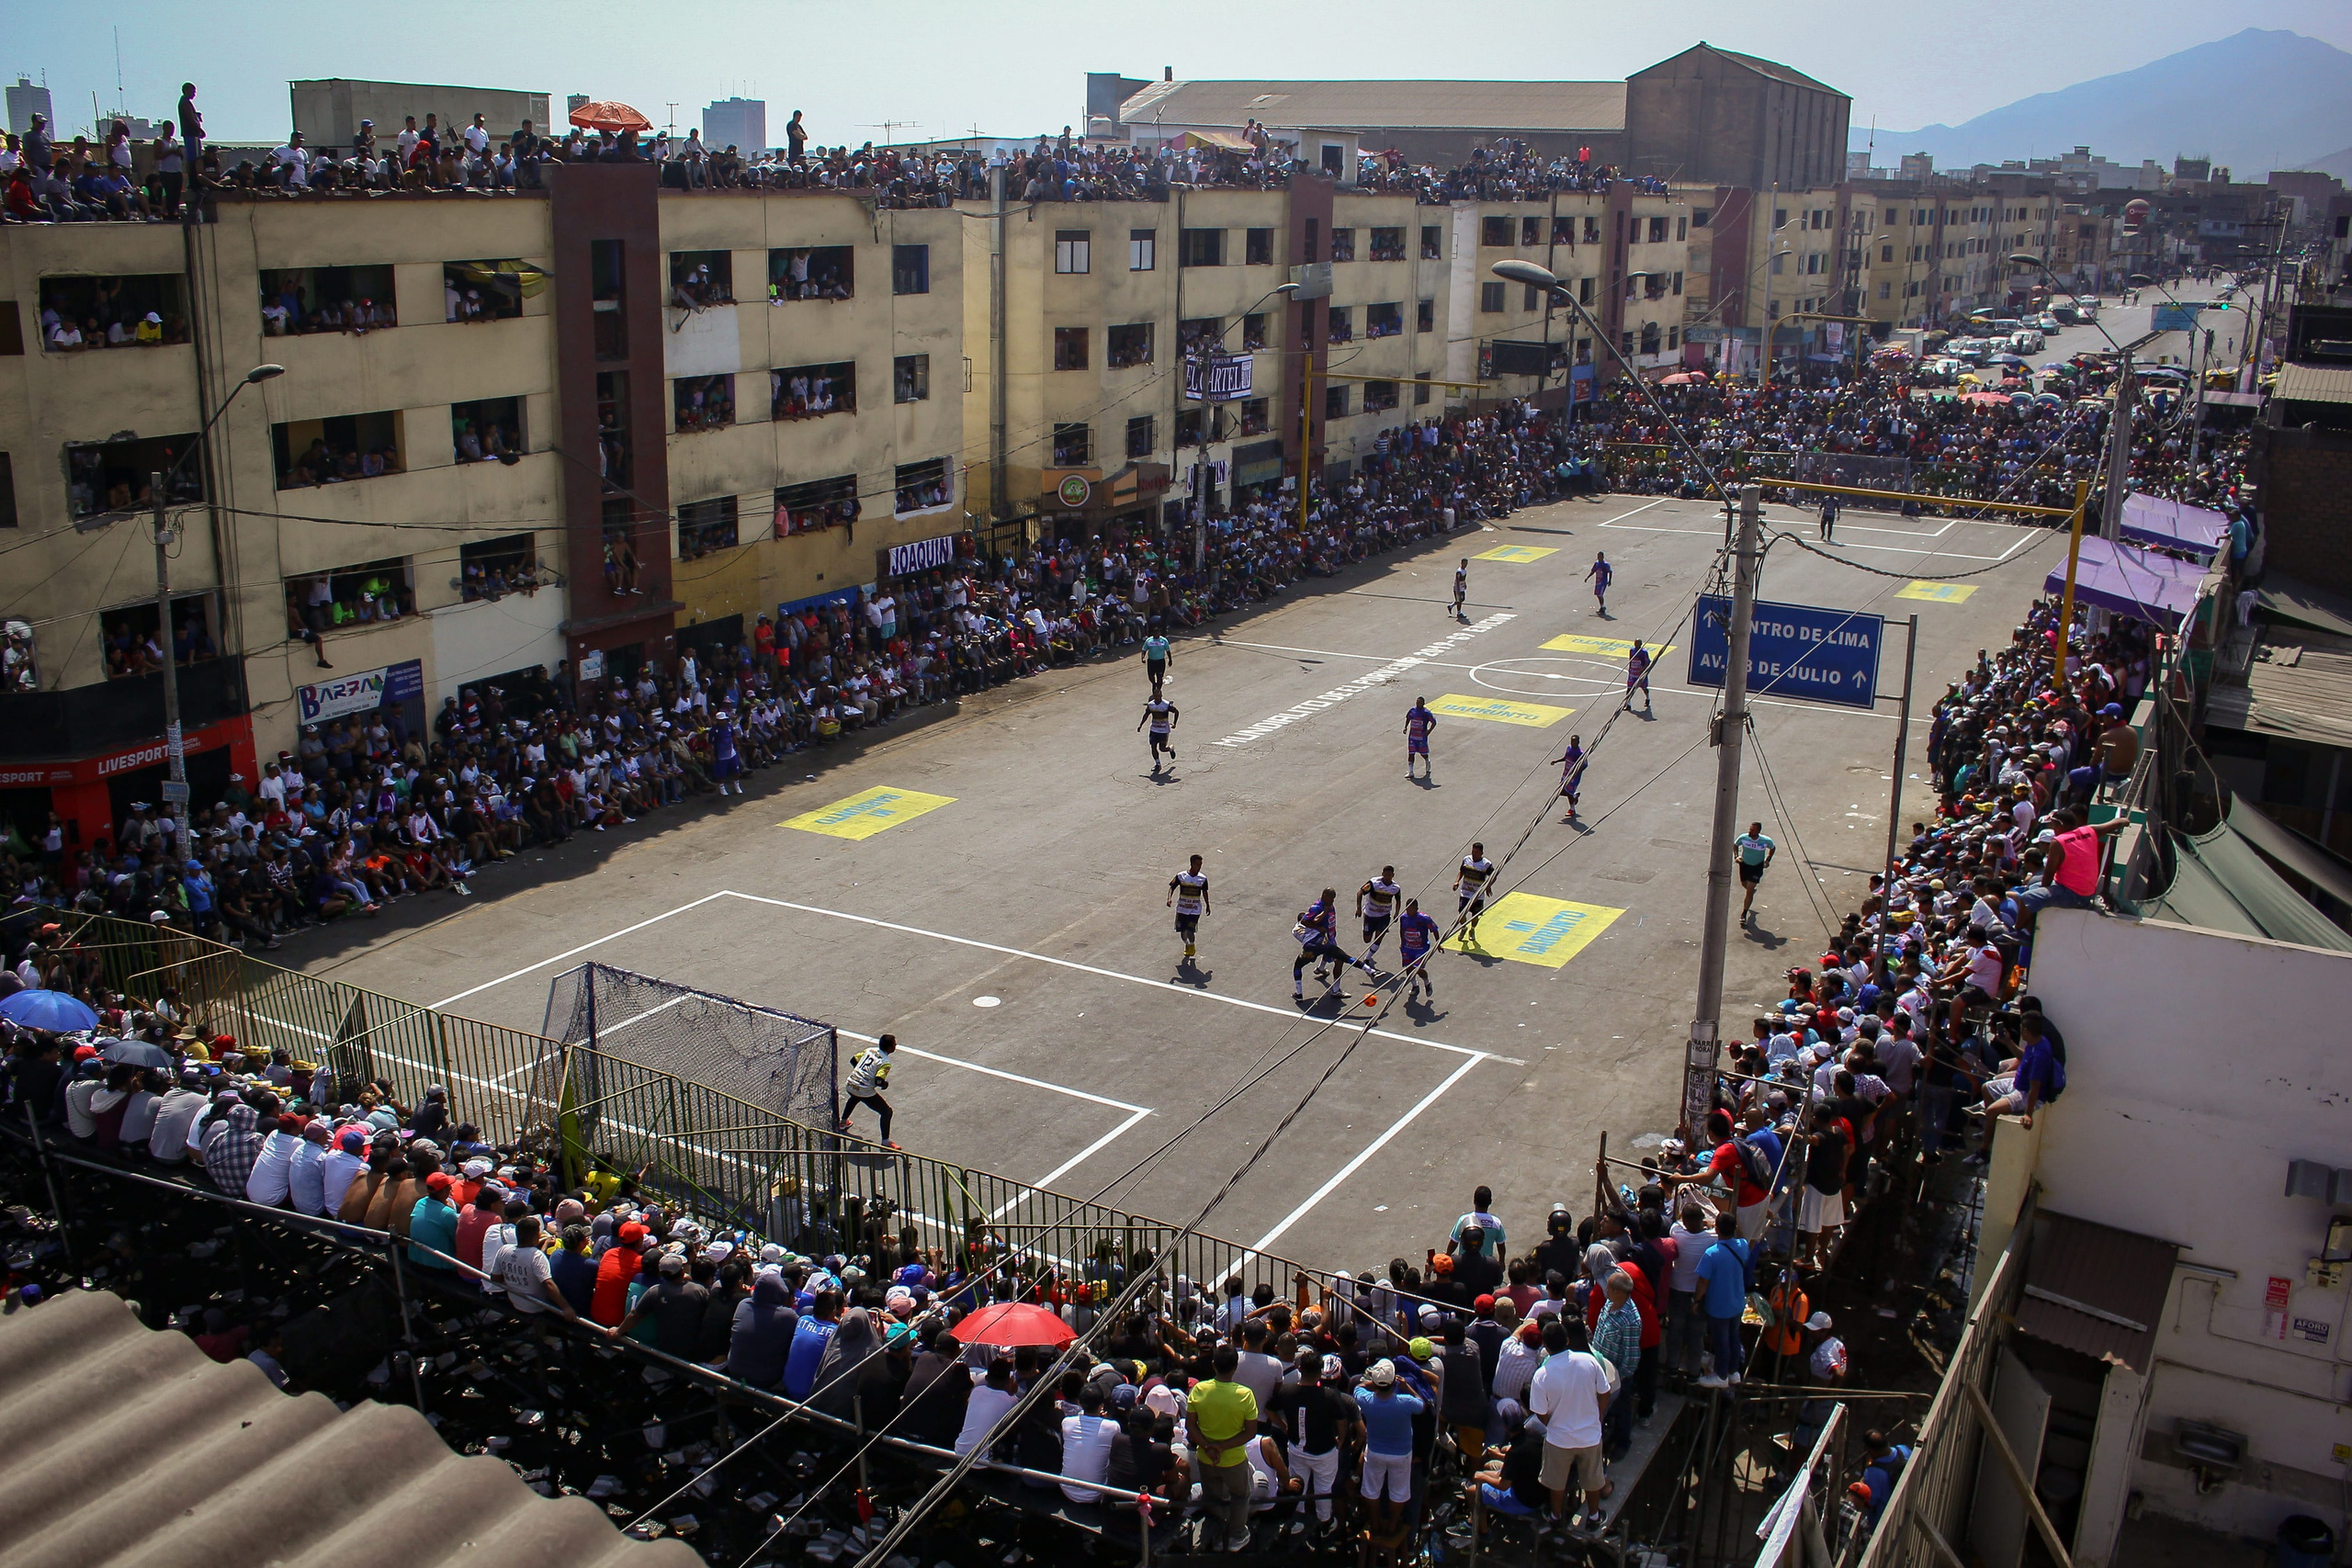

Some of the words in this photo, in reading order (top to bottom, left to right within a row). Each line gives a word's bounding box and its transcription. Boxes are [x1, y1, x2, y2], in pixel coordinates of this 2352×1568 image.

[1186, 365, 1198, 390] EL
[891, 538, 951, 576] JOAQUIN
[1749, 620, 1795, 638] NTRO
[1800, 626, 1822, 642] DE
[1828, 629, 1870, 649] LIMA
[1700, 653, 1725, 670] AV.
[1758, 660, 1781, 676] DE
[1787, 665, 1841, 684] JULIO
[1211, 700, 1334, 747] MUNDIALITO
[1442, 704, 1540, 720] BARRUNTO
[97, 744, 170, 775] LIVESPORT
[0, 772, 44, 784] SPORT
[815, 793, 902, 825] BARRUNTO
[866, 808, 897, 818] MI
[1504, 919, 1538, 932] MI
[1516, 910, 1587, 954] BARRUNTO
[859, 1054, 874, 1071] 12
[797, 1319, 834, 1337] ITALIA
[2296, 1320, 2327, 1332] AFORO
